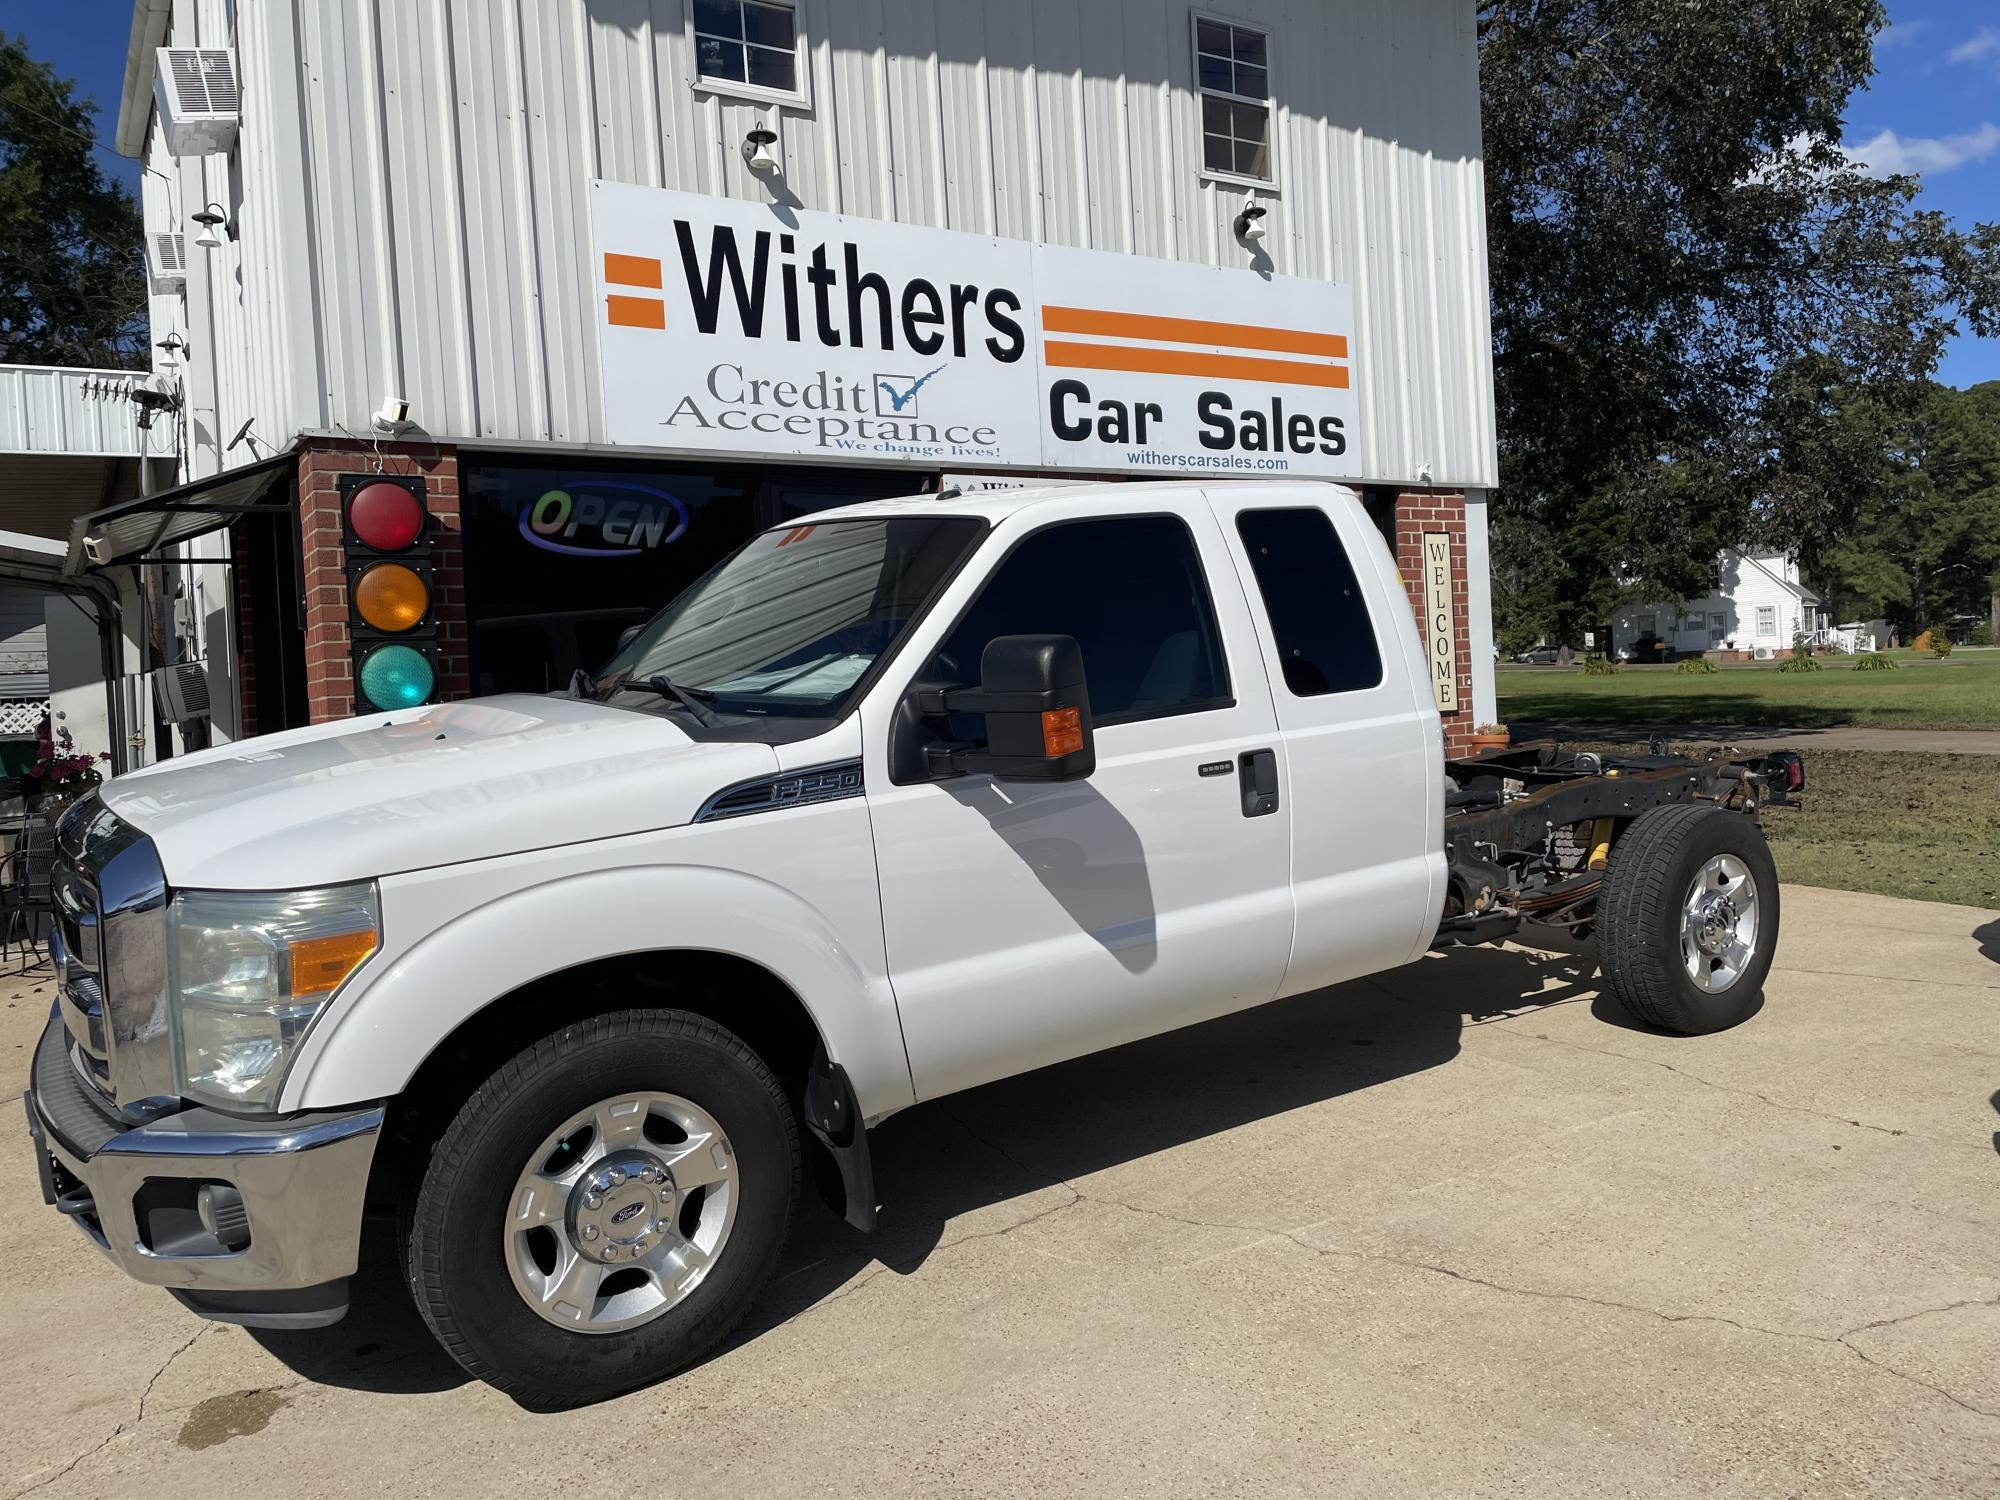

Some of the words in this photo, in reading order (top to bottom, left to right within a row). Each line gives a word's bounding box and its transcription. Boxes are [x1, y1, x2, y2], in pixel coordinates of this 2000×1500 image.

[673, 219, 1026, 364] Withers
[706, 363, 869, 414] Credit
[657, 395, 997, 447] Acceptance
[1050, 378, 1164, 445] Car
[1197, 390, 1347, 456] Sales
[834, 438, 867, 451] We
[873, 441, 945, 457] change
[951, 446, 1001, 458] lives!
[1127, 450, 1289, 470] witherscarsales.com
[531, 489, 672, 549] OPEN
[1429, 543, 1451, 703] WELCOME
